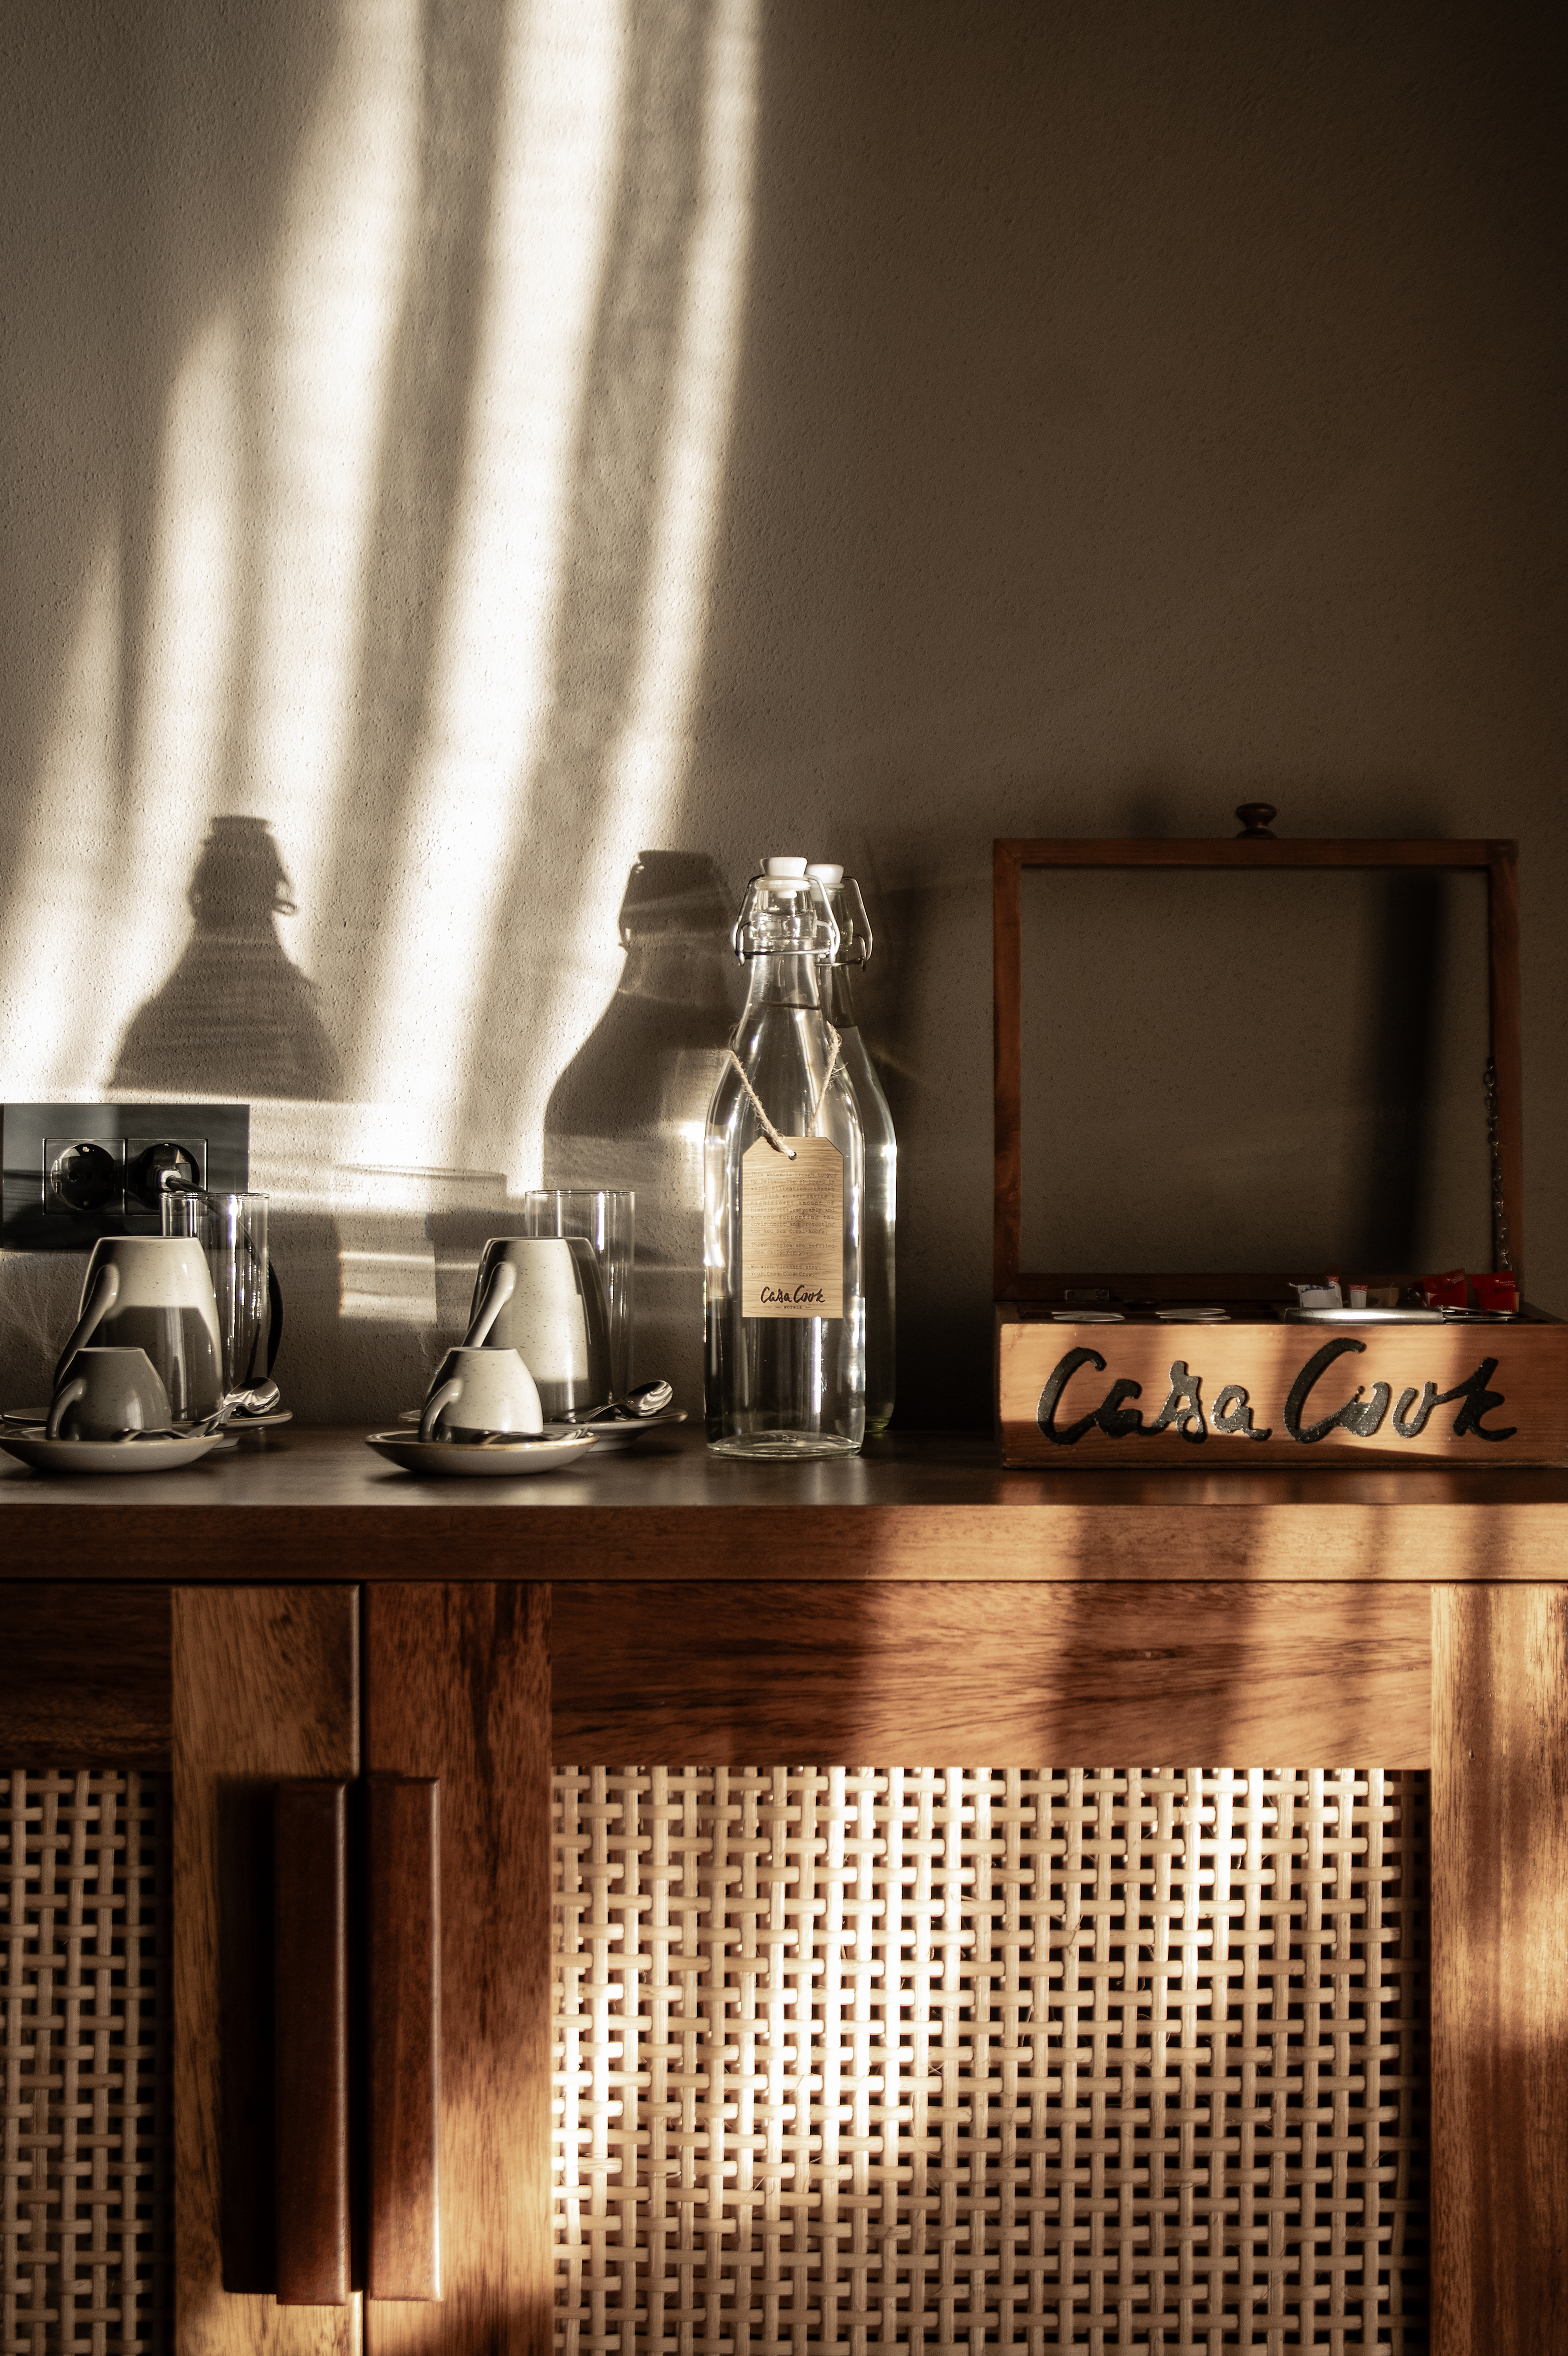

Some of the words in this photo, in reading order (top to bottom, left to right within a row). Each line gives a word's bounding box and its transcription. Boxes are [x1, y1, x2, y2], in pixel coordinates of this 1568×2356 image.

[760, 1286, 792, 1303] Casa
[794, 1285, 825, 1303] Cook
[1037, 1347, 1272, 1445] Casa
[1283, 1337, 1517, 1443] Cook
